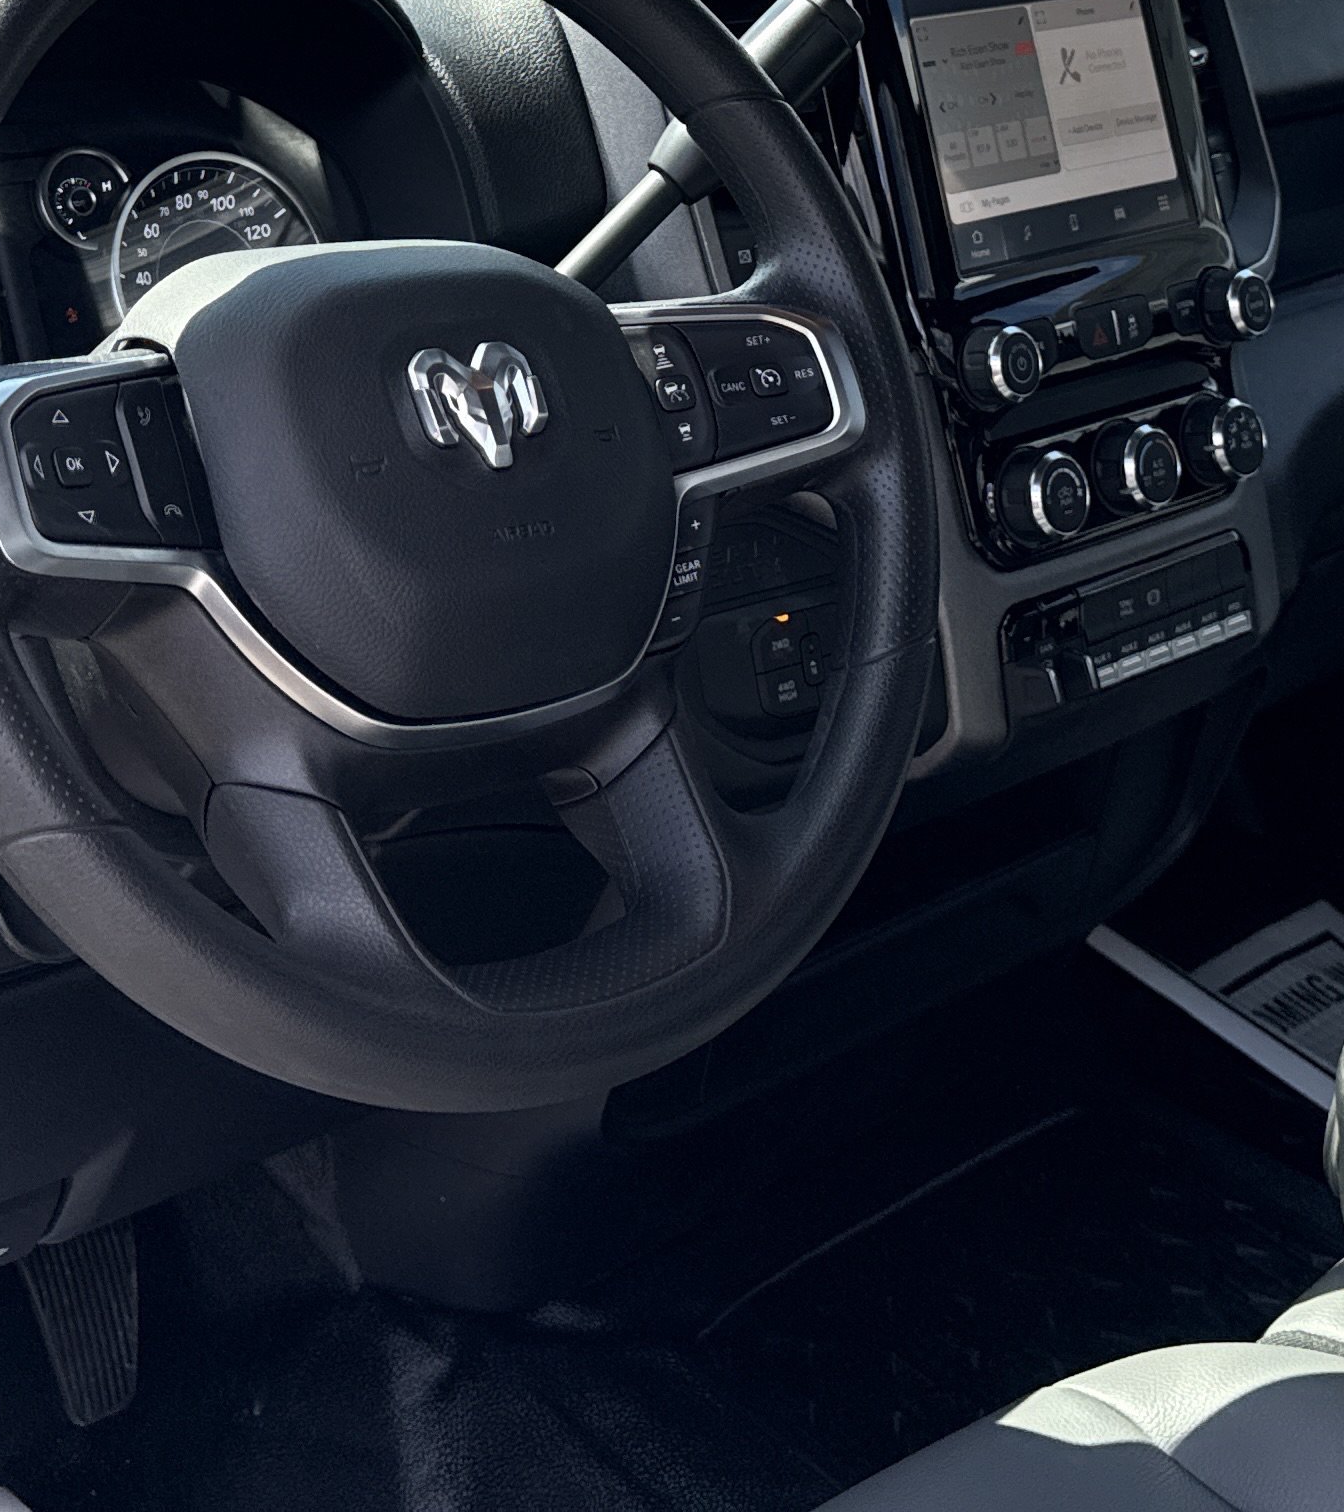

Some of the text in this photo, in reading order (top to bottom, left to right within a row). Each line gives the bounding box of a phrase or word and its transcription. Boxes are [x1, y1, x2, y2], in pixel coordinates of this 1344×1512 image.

[101, 180, 113, 193] H
[175, 192, 192, 211] 80
[197, 189, 209, 200] 90
[210, 195, 236, 212] 100
[159, 205, 170, 217] 70
[239, 206, 255, 217] 110
[143, 223, 160, 240] 60
[244, 223, 271, 241] 120
[136, 270, 152, 286] 40
[794, 367, 815, 380] RES
[721, 380, 746, 394] CANC
[66, 457, 84, 471] OK
[675, 559, 702, 574] GEAR
[673, 571, 699, 587] LIMIT
